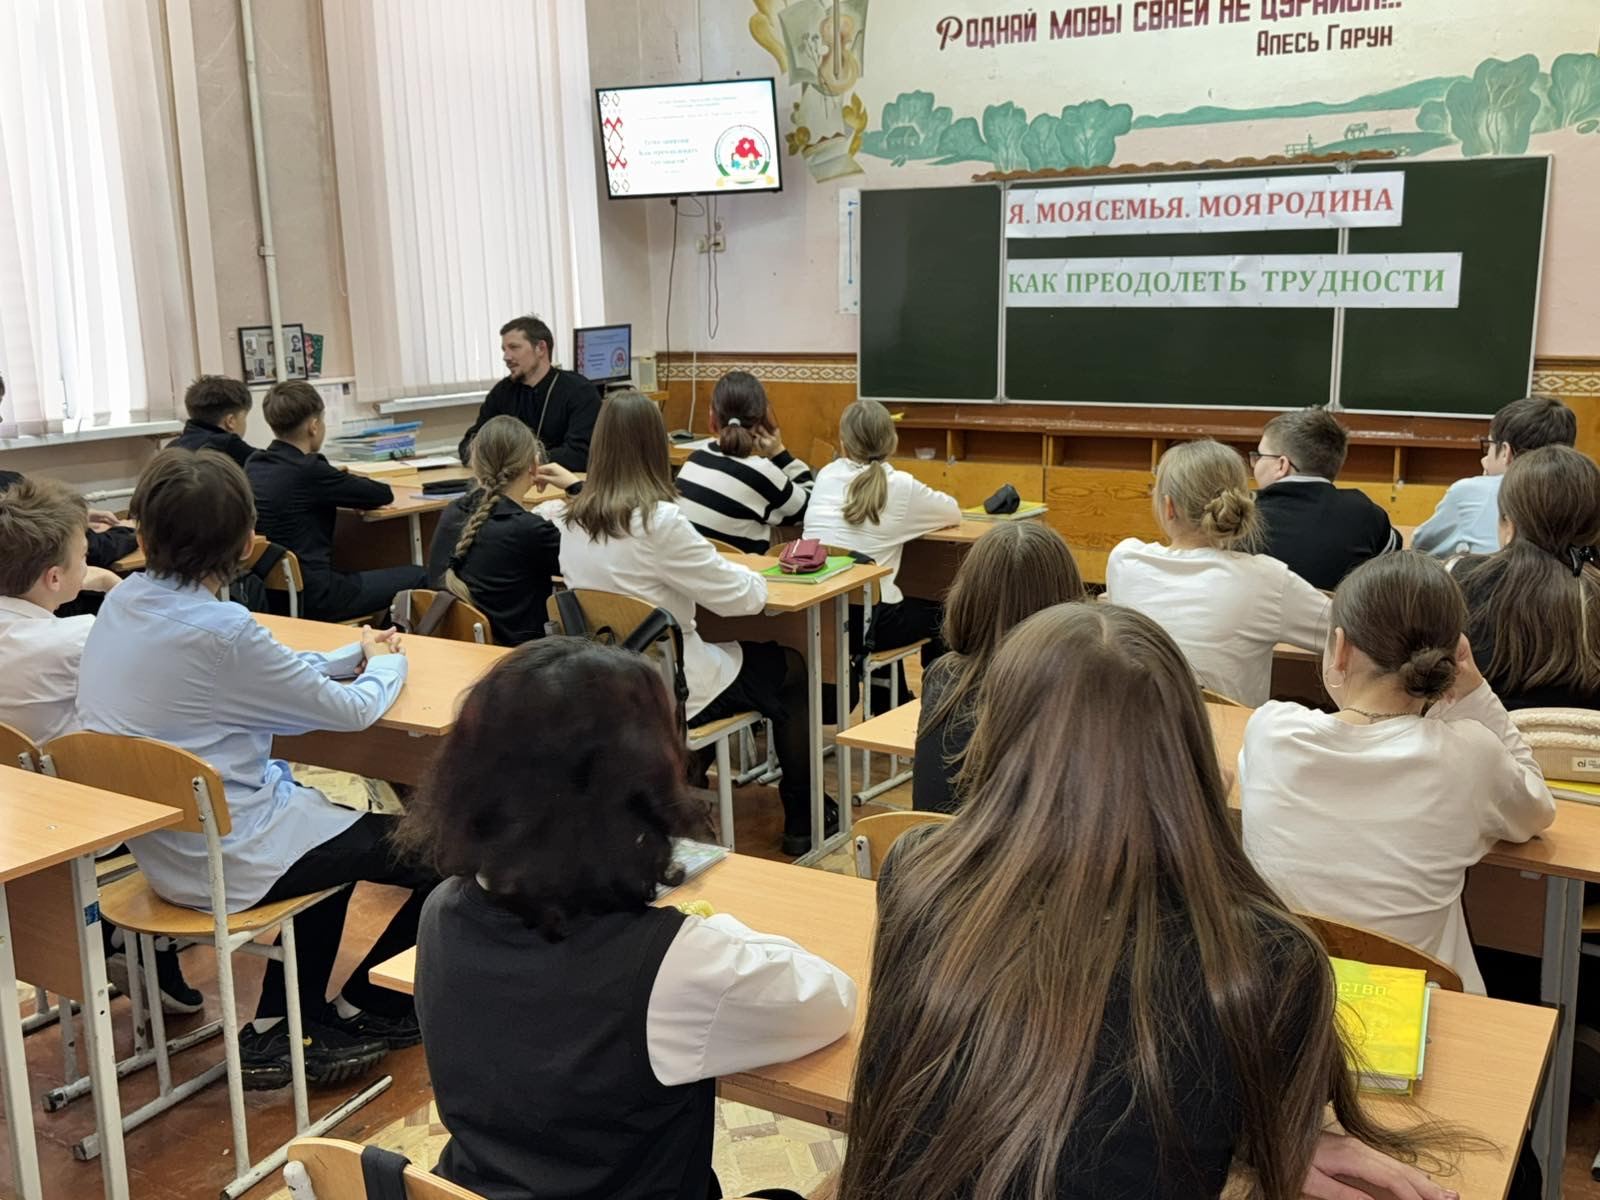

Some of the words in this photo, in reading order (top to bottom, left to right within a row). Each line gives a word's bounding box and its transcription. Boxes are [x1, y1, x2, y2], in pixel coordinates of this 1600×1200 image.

[936, 8, 1037, 50] РОДНАЙ
[1050, 4, 1122, 40] МОВЫ
[1219, 0, 1250, 24] НЕ
[1008, 204, 1030, 224] Я.
[1008, 273, 1057, 293] КАК
[1066, 271, 1247, 296] ПРЕОДОЛЕТЬ
[1262, 269, 1445, 296] ТРУДНОСТИ
